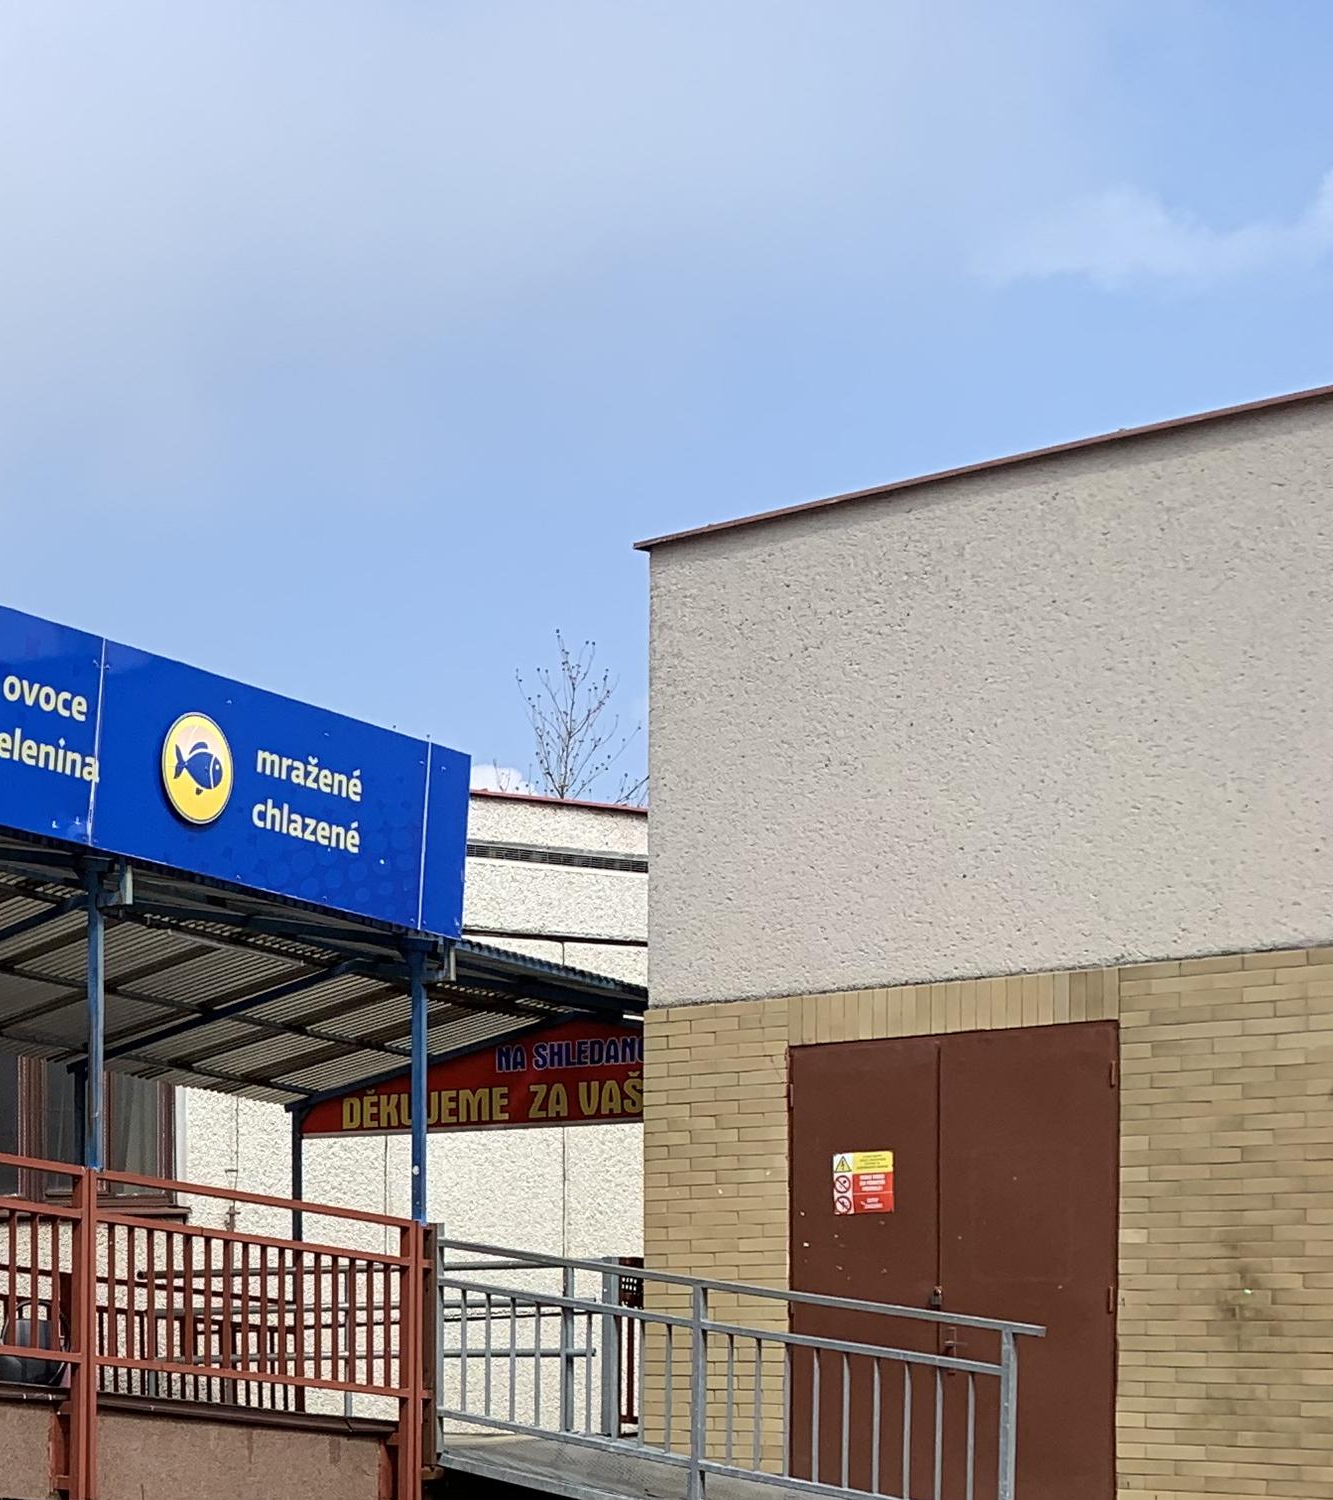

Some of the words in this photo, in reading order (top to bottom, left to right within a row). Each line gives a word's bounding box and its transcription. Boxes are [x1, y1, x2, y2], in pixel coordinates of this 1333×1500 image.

[2, 674, 88, 723] ovoce
[256, 748, 363, 802] mražené
[251, 799, 361, 855] chlazené
[496, 1044, 527, 1073] NA
[533, 1036, 644, 1070] SHLEDAN
[342, 1088, 510, 1130] DĚKUJEME
[529, 1082, 568, 1119] ZA
